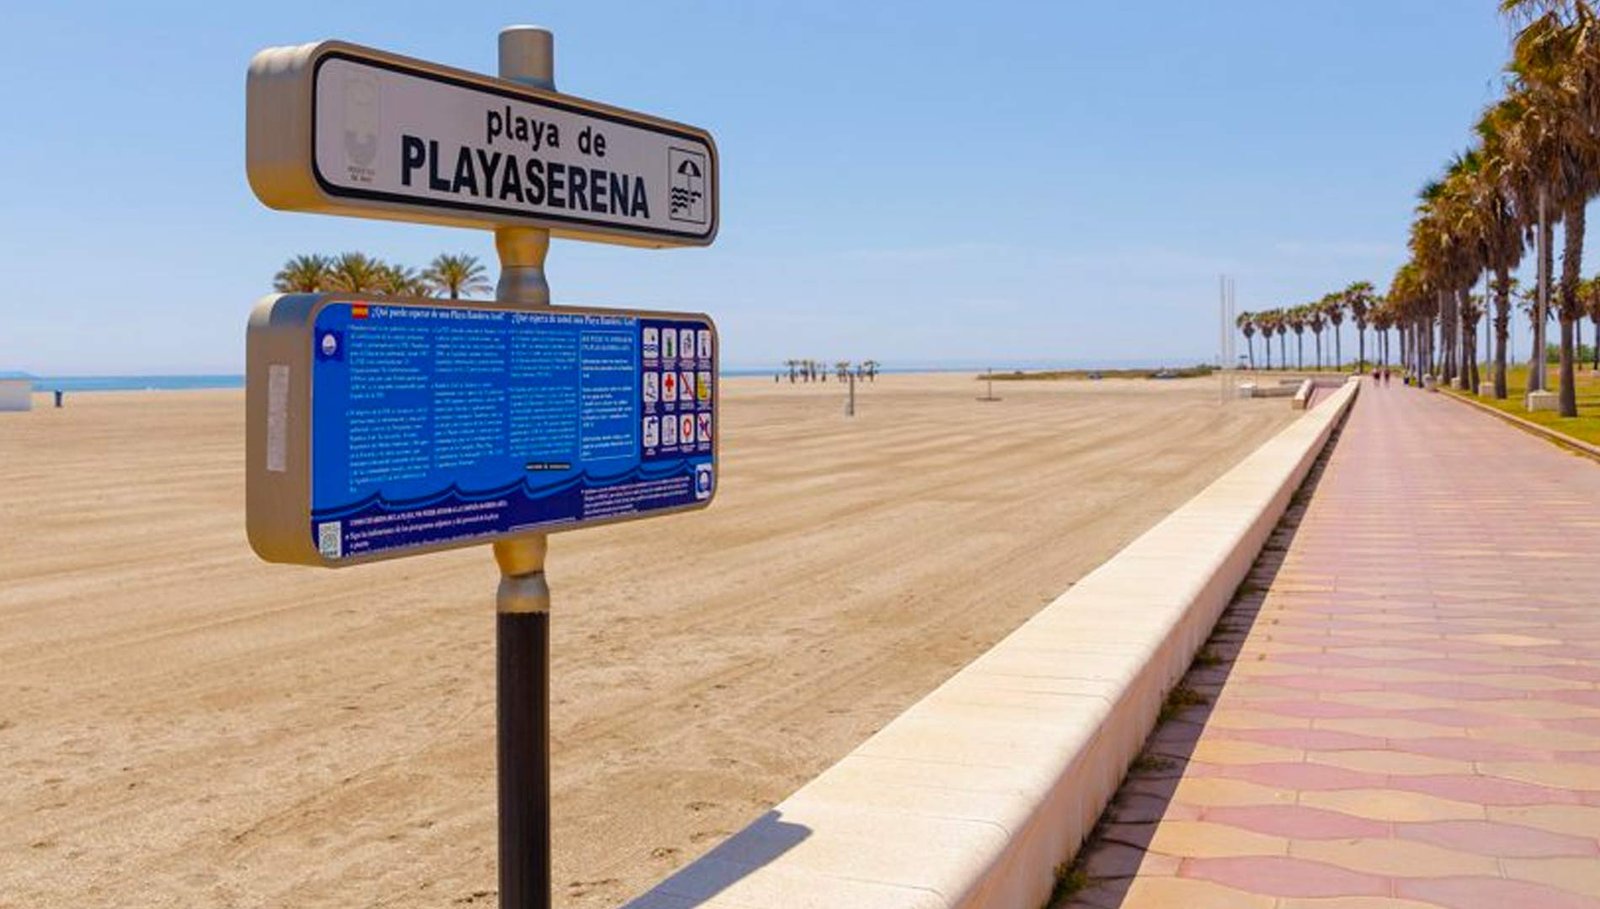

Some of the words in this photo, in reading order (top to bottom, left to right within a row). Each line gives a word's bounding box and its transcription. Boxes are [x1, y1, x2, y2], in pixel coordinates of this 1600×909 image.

[486, 105, 560, 150] playa
[578, 126, 606, 158] de
[401, 134, 650, 219] PLAYASERENA
